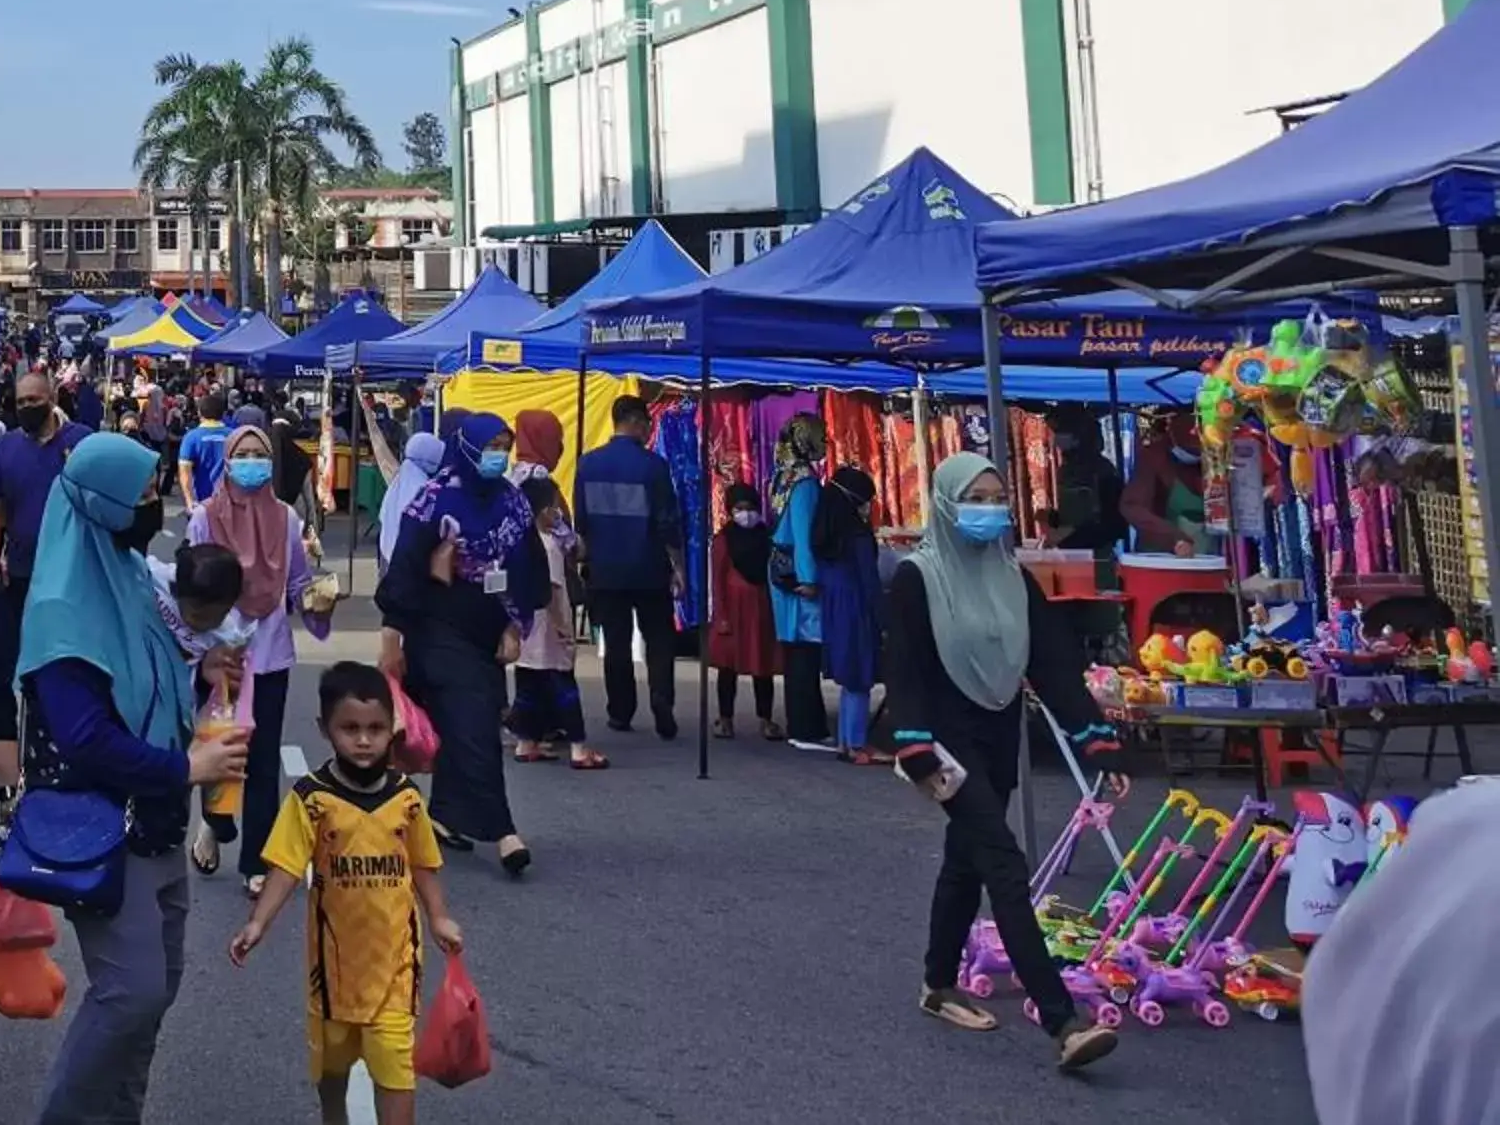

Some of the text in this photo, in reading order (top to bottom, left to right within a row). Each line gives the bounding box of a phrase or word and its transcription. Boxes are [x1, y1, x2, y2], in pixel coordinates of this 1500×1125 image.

[997, 312, 1145, 339] Pasar Tani
[1080, 334, 1227, 356] pasar pilihan
